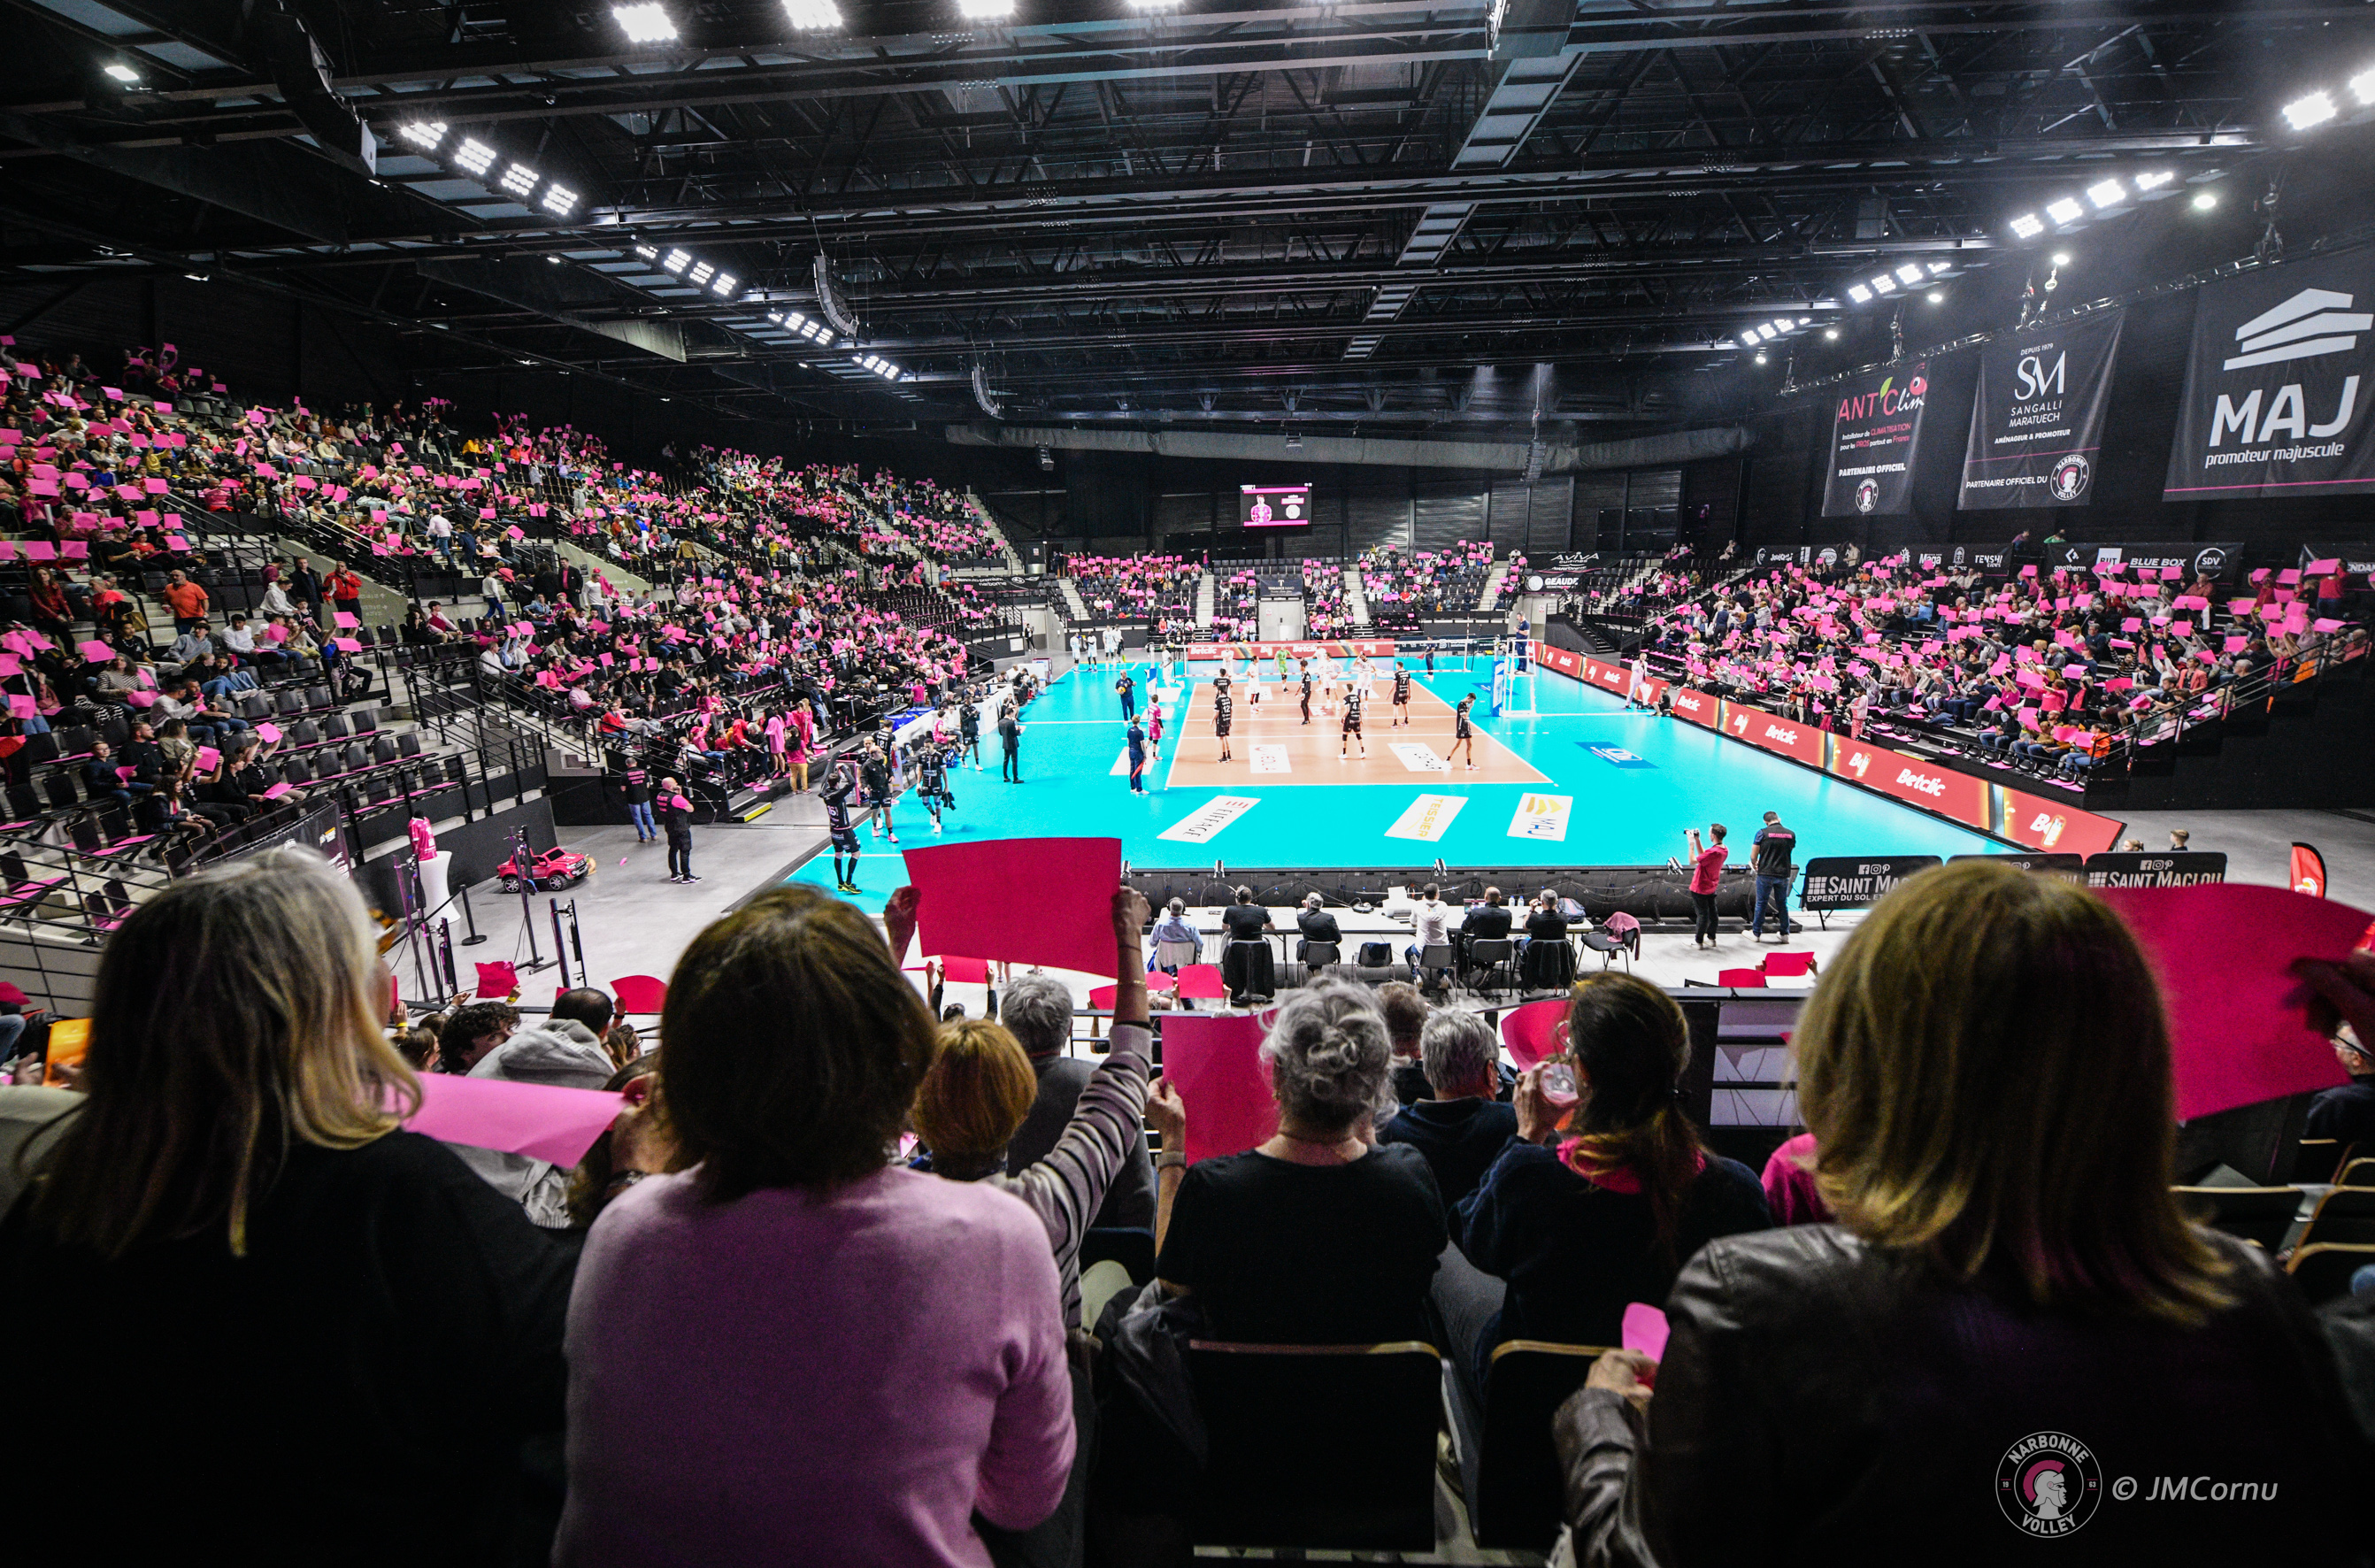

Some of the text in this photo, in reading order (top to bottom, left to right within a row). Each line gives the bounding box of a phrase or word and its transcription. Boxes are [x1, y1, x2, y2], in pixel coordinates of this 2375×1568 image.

[2020, 342, 2054, 356] DEPUIS 1979
[2014, 350, 2065, 401] SM
[2010, 400, 2063, 417] SANGALLI
[2209, 374, 2361, 447] MAJ
[2009, 411, 2061, 427] MARATUECH
[1871, 423, 1911, 436] CLIMATISATION
[1995, 434, 2028, 444] AMÉNAGEUR
[2034, 428, 2071, 440] PROMOTEUR
[2056, 455, 2087, 471] NARBONNE
[2205, 442, 2345, 469] promoteur majuscule
[1838, 463, 1906, 477] PARTENAIRE OFFICIEL
[1965, 475, 2048, 488] PARTENAIRE OFFICIEL DU
[2057, 489, 2078, 499] VOLLEY
[1974, 554, 2003, 564] TENSHI
[2130, 557, 2187, 567] BLUE BOX
[2202, 557, 2220, 565] SDV
[1677, 695, 1702, 712] Betclic
[1764, 724, 1798, 746] Betclic
[1895, 768, 1946, 796] Betclic
[1183, 808, 1233, 838] EIFFAGE
[1416, 797, 1444, 838] TEISSIER
[1526, 817, 1556, 837] MAJ
[1828, 876, 1872, 895] SAINT
[2108, 871, 2155, 888] SAINT
